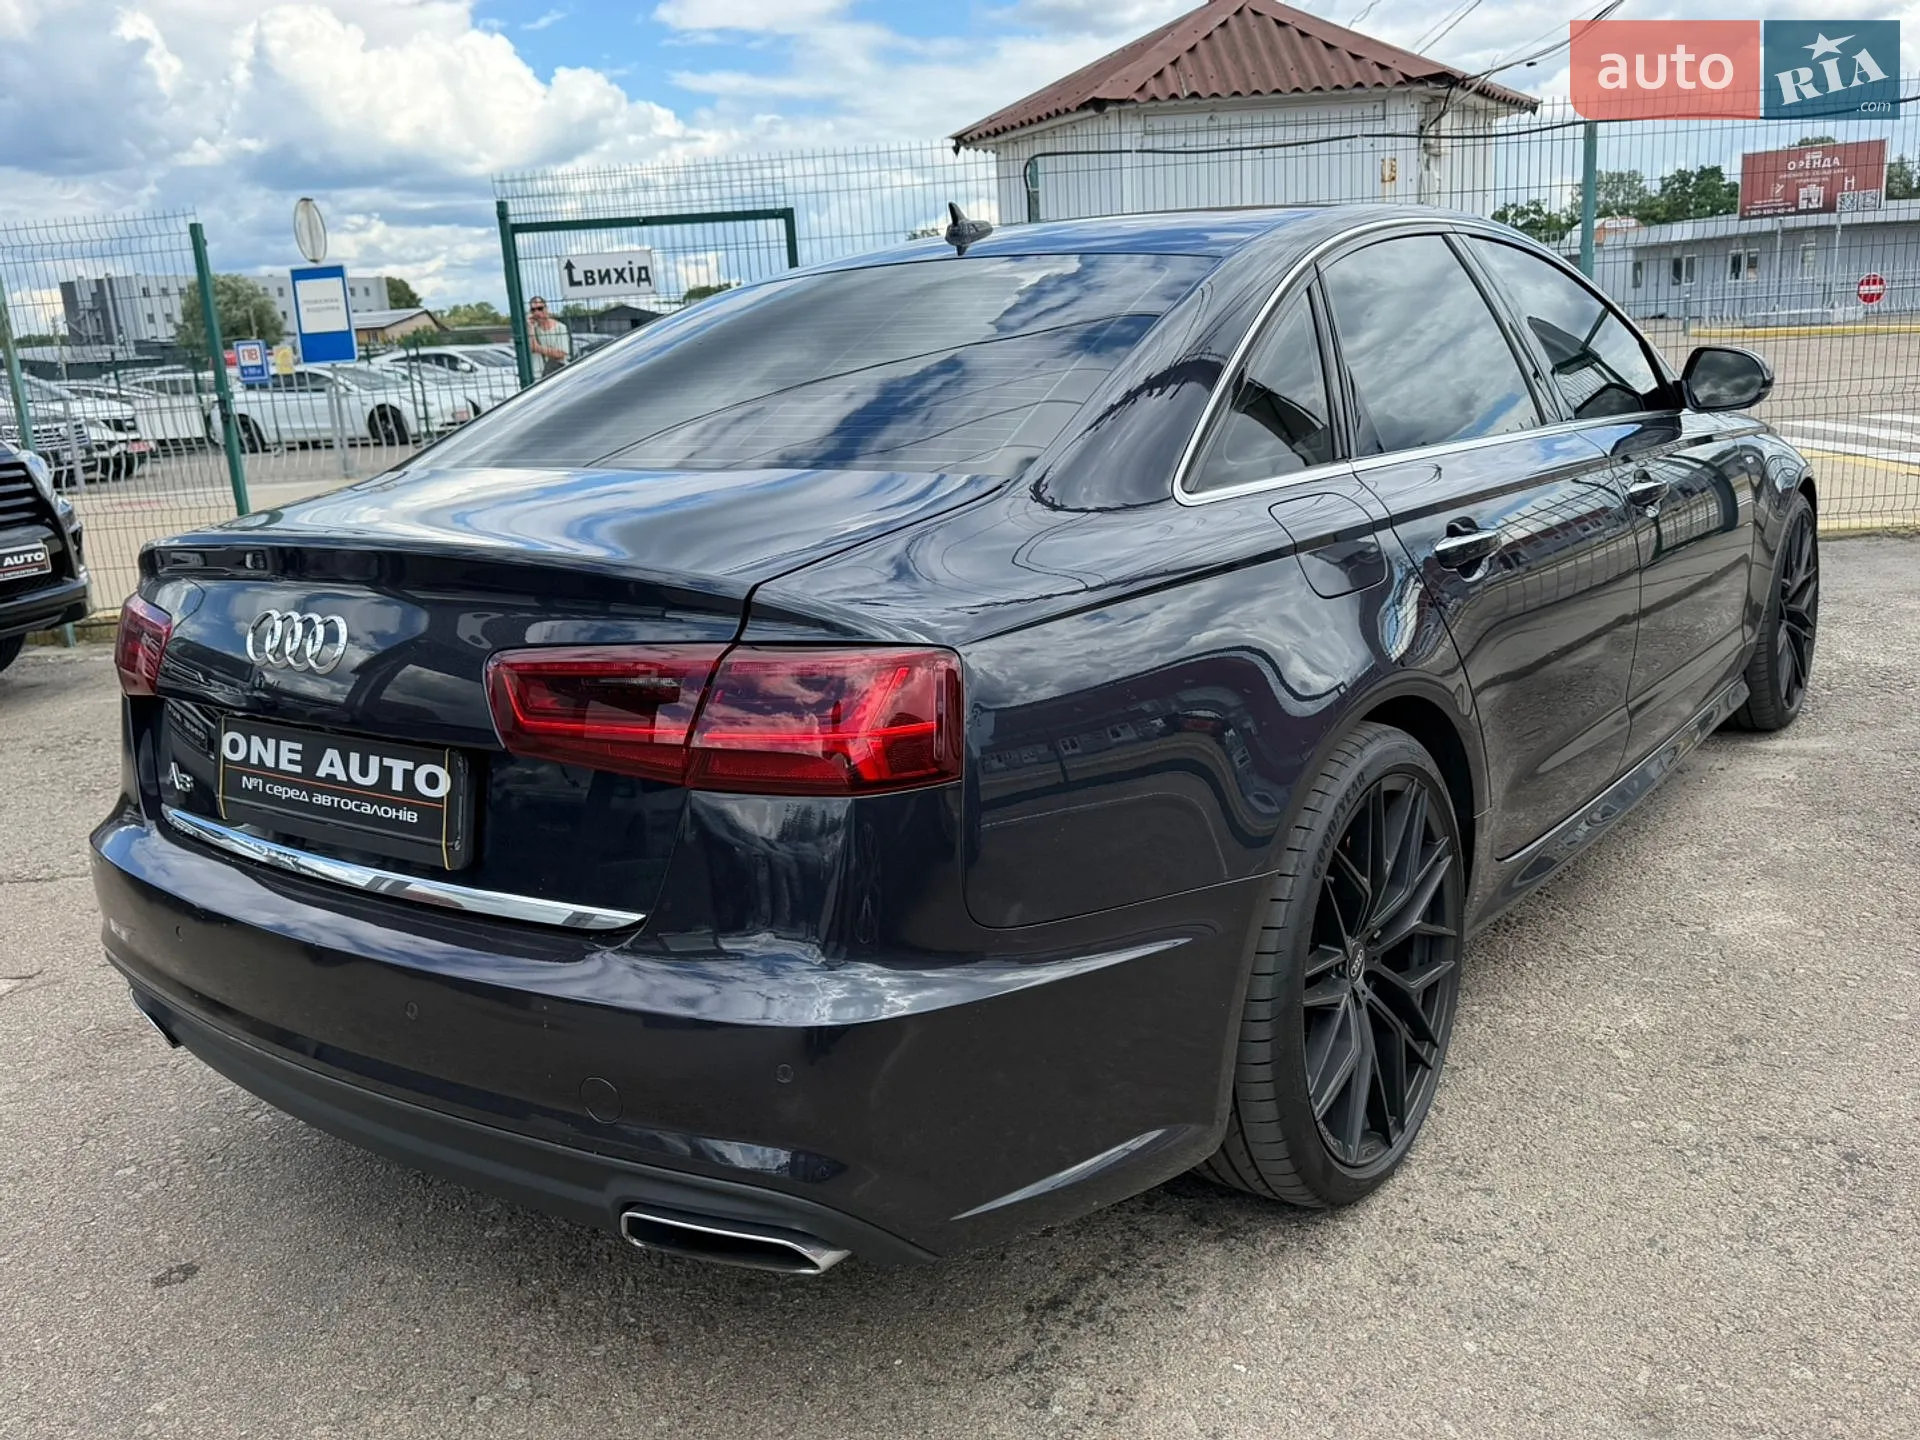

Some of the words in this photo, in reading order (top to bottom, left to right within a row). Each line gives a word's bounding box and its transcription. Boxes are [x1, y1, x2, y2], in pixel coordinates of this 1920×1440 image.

[1787, 156, 1840, 171] ОРЕНДА
[3, 552, 45, 567] AUTO
[222, 731, 303, 773] ONE
[315, 748, 451, 798] AUTO
[265, 783, 309, 801] серед
[312, 792, 418, 824] автосалонів
[1311, 771, 1366, 879] GOODYEAR
